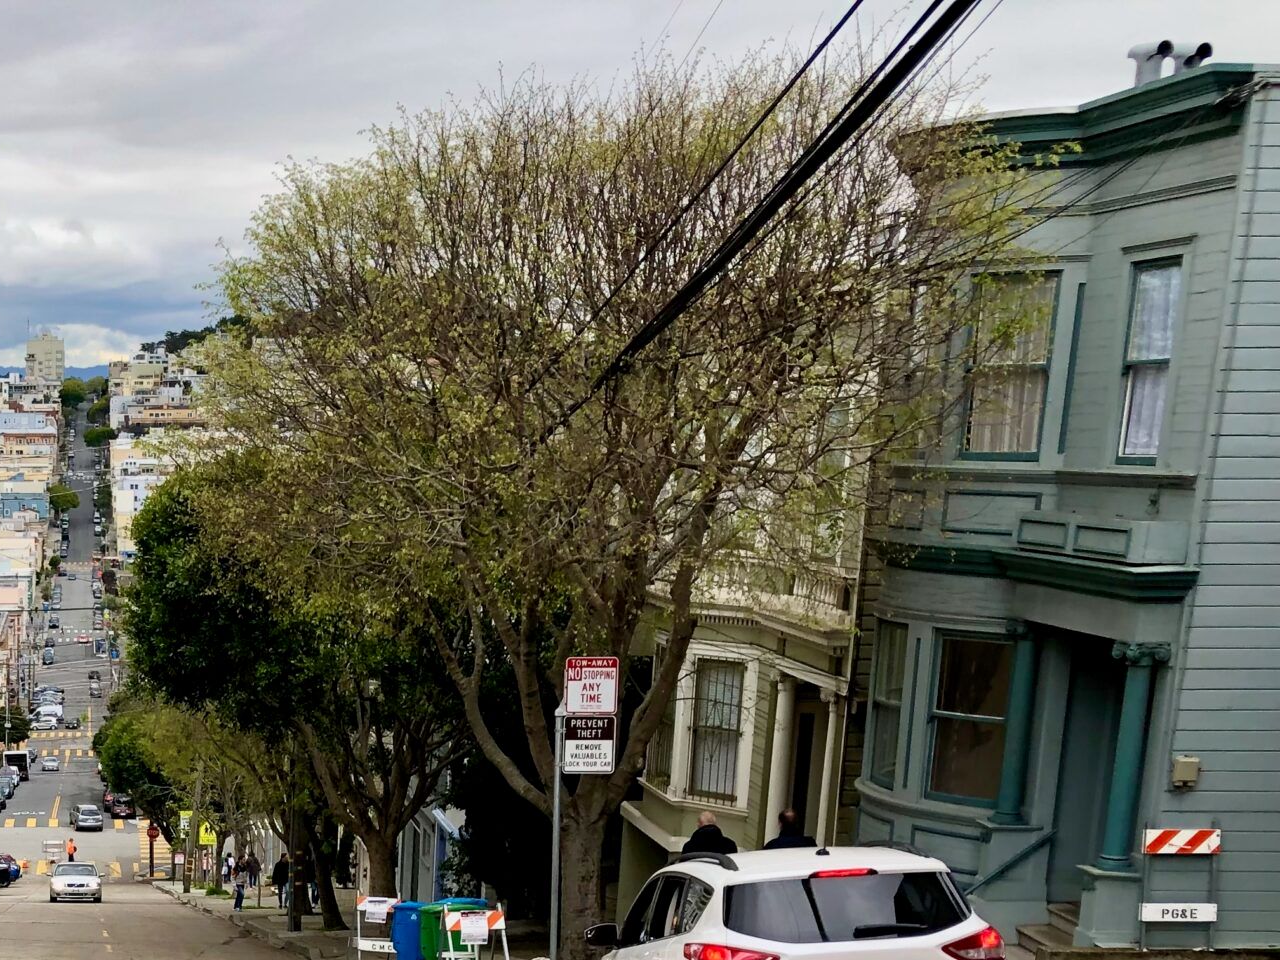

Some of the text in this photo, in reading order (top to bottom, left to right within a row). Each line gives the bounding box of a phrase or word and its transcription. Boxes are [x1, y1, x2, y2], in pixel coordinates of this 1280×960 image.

[572, 659, 614, 667] TOW-AWAY
[568, 667, 615, 680] NO STOPPING
[582, 682, 602, 692] ANY
[580, 693, 603, 704] TIME
[570, 719, 609, 728] PREVENT
[577, 729, 602, 738] THEFT
[575, 743, 602, 751] REMOVE
[570, 752, 608, 760] VALUABLES
[565, 760, 612, 768] LOCK YOUR CAR
[1161, 908, 1198, 919] PG&E
